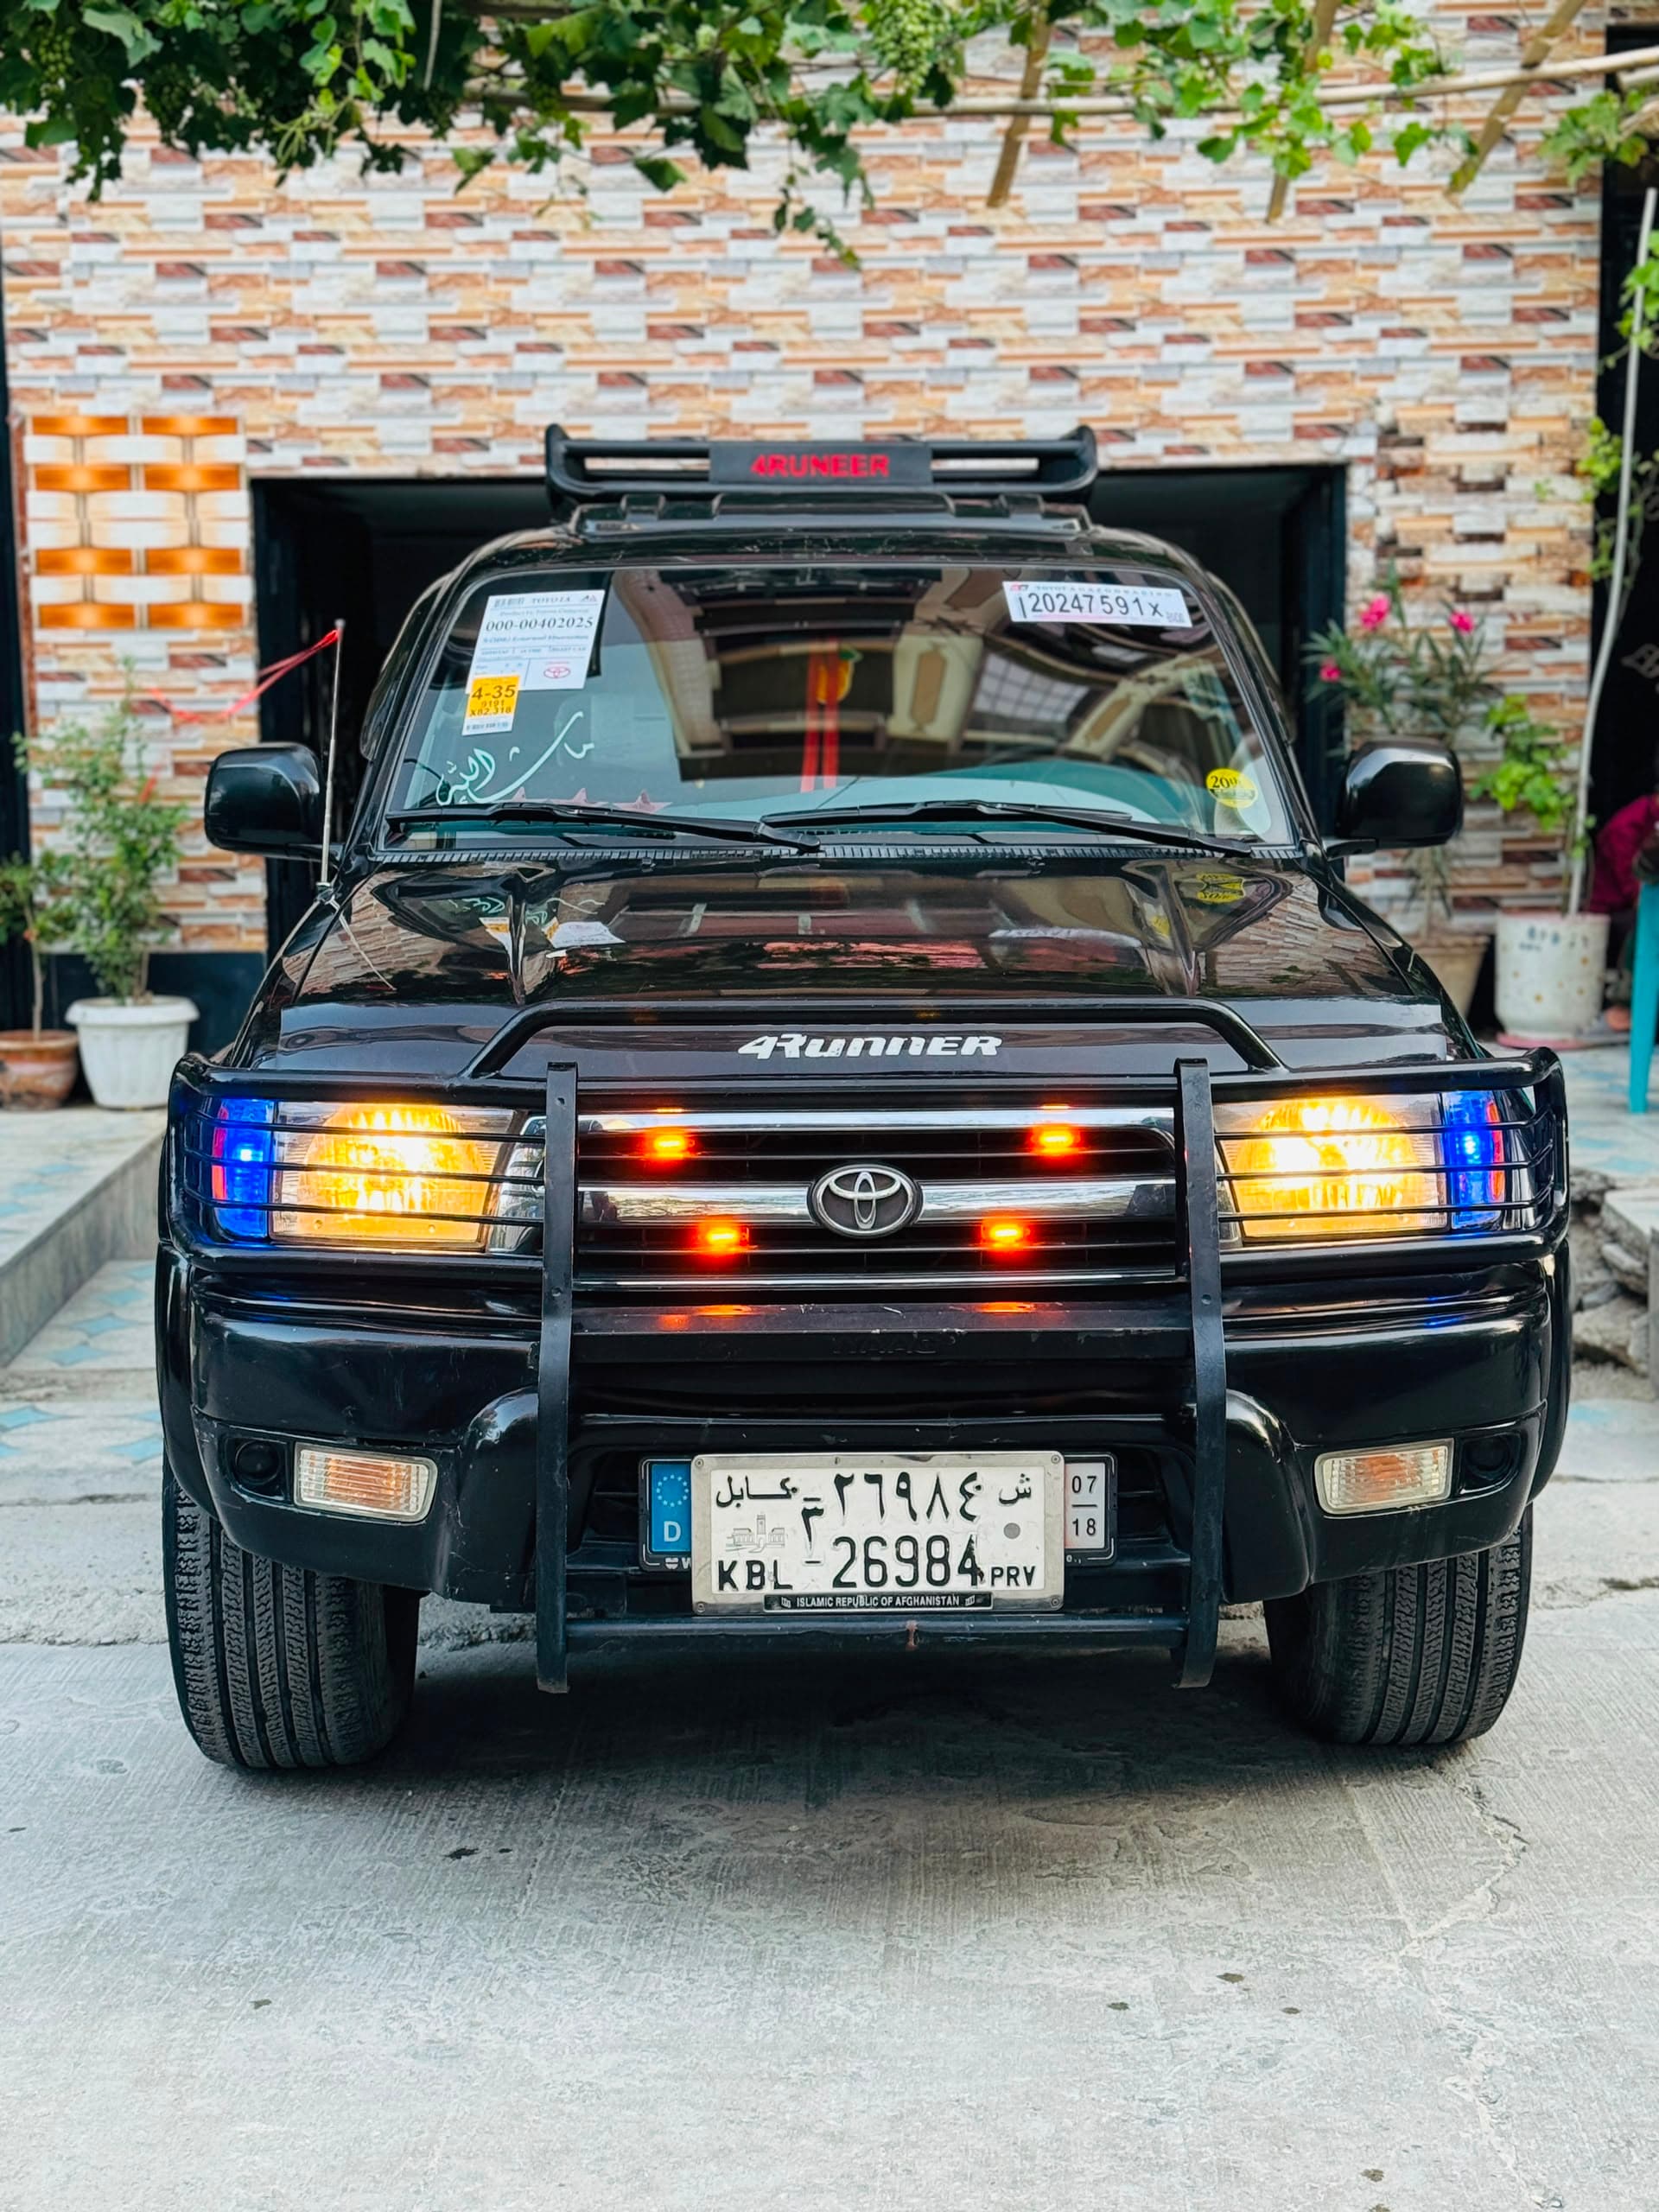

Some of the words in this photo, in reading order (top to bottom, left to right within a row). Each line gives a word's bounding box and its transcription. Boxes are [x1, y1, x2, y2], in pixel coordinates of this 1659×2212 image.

[471, 684, 517, 700] 4-35
[999, 1473, 1032, 1504] ش
[1071, 1476, 1097, 1493] 07
[664, 1521, 682, 1542] D
[1072, 1518, 1096, 1536] 18
[718, 1560, 793, 1591] KBL
[832, 1535, 980, 1588] 26984
[991, 1566, 1035, 1586] PRV
[797, 1598, 833, 1607] ISLAMIC
[836, 1596, 879, 1606] REPUBLIC
[880, 1597, 893, 1606] OF
[895, 1595, 960, 1606] AFGHANISTAN
